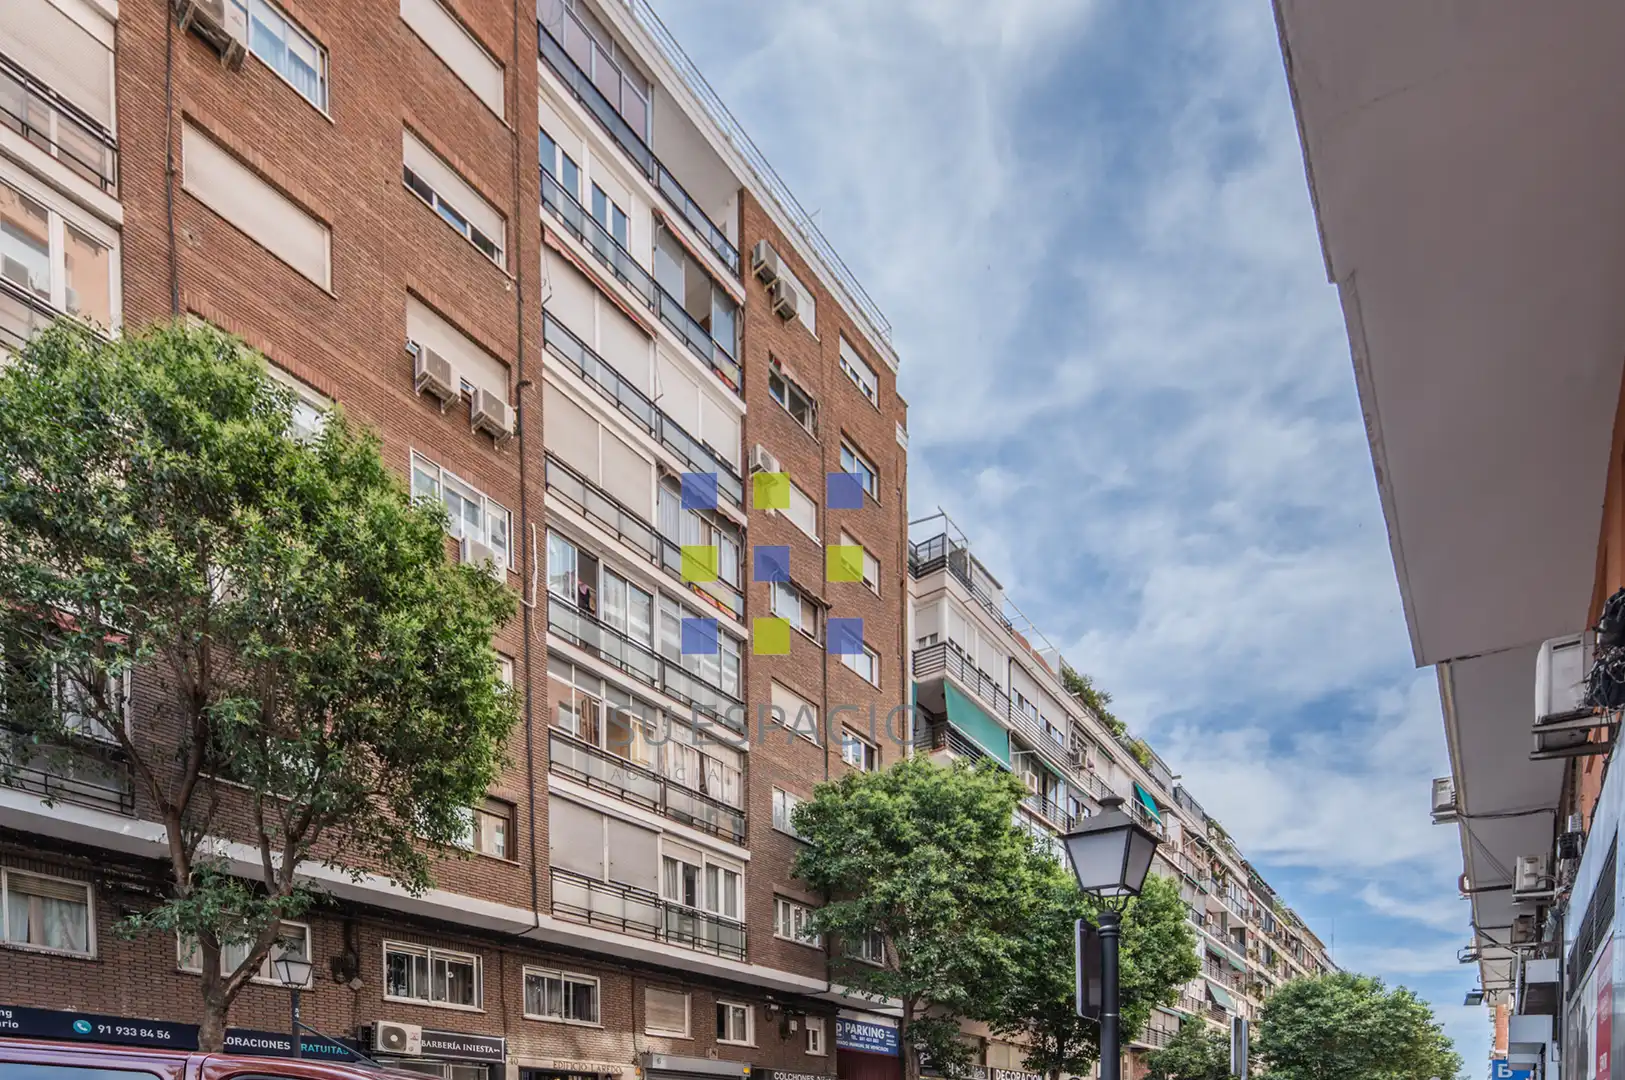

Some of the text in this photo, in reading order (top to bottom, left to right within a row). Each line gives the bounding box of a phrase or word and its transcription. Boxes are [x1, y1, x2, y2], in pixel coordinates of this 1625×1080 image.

[97, 1024, 171, 1040] 91 933 84 56
[845, 1022, 885, 1040] PARKING
[421, 1039, 494, 1054] BARBERÍA INIESTA
[553, 1060, 588, 1072] EDIFICIO
